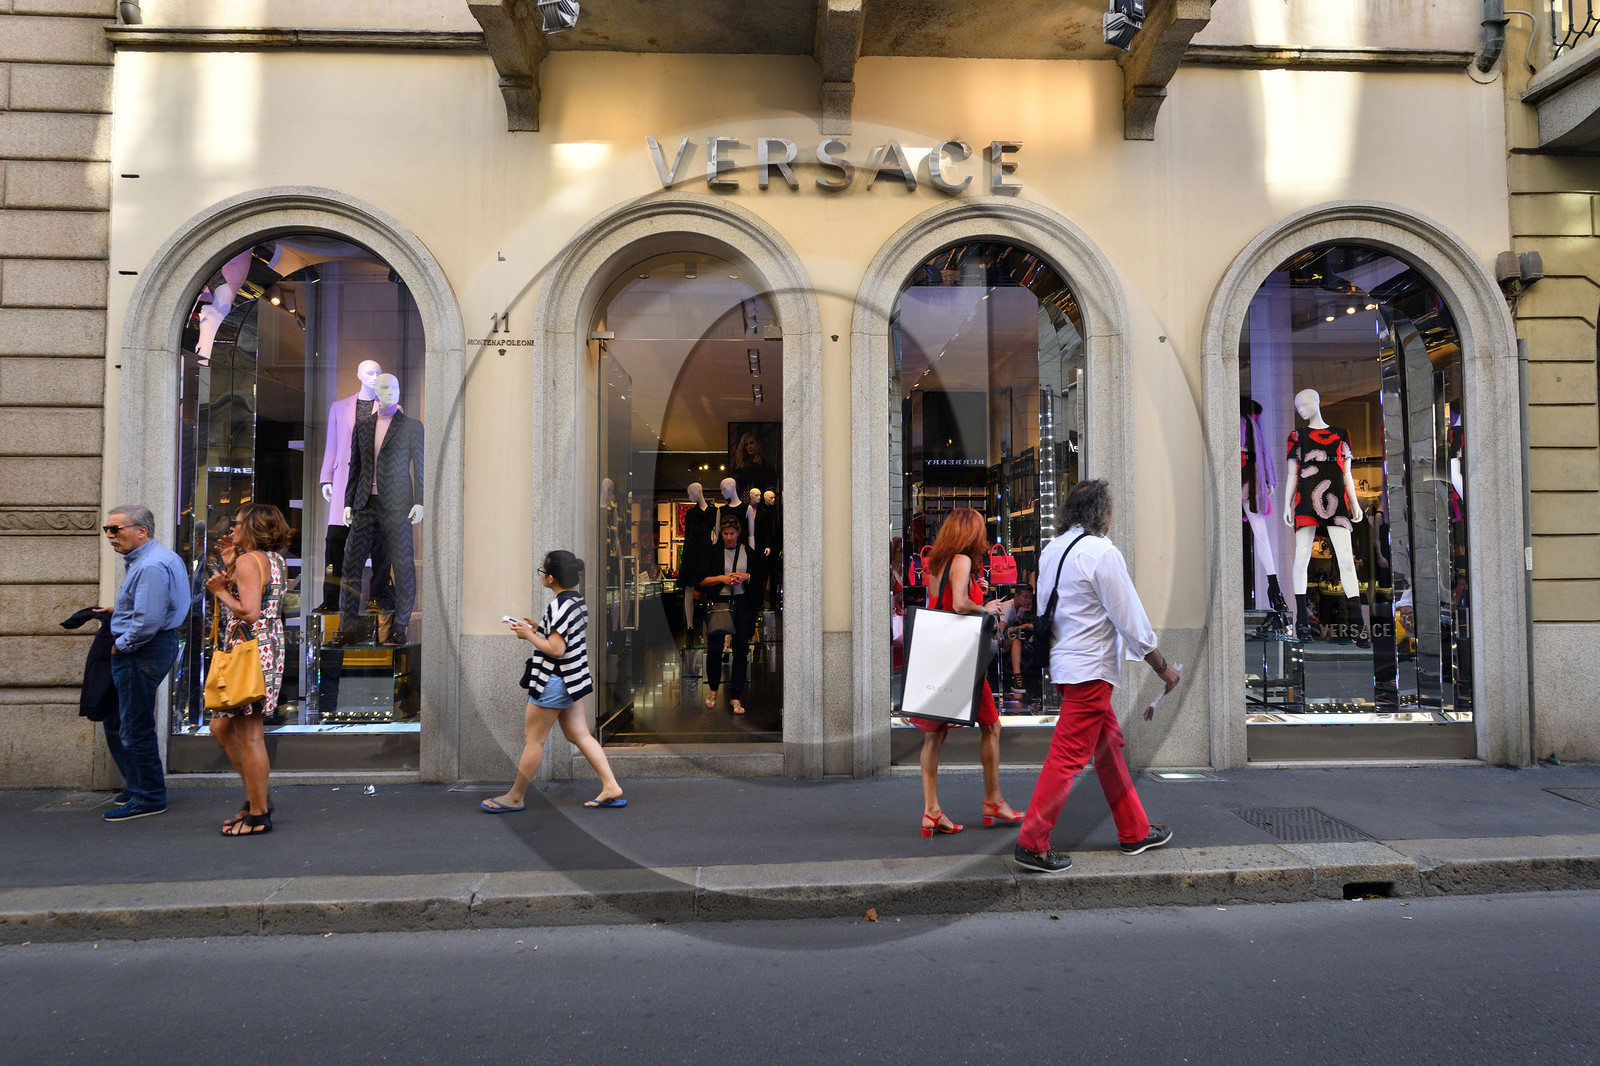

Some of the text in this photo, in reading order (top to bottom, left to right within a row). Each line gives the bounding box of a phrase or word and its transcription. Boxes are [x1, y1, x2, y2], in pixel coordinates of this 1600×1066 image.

[645, 136, 1024, 194] VERSACE
[490, 312, 510, 333] 11
[467, 339, 535, 347] MONTENAPOLEONE
[1320, 623, 1392, 638] VERSACE
[926, 684, 953, 694] GUCCI
